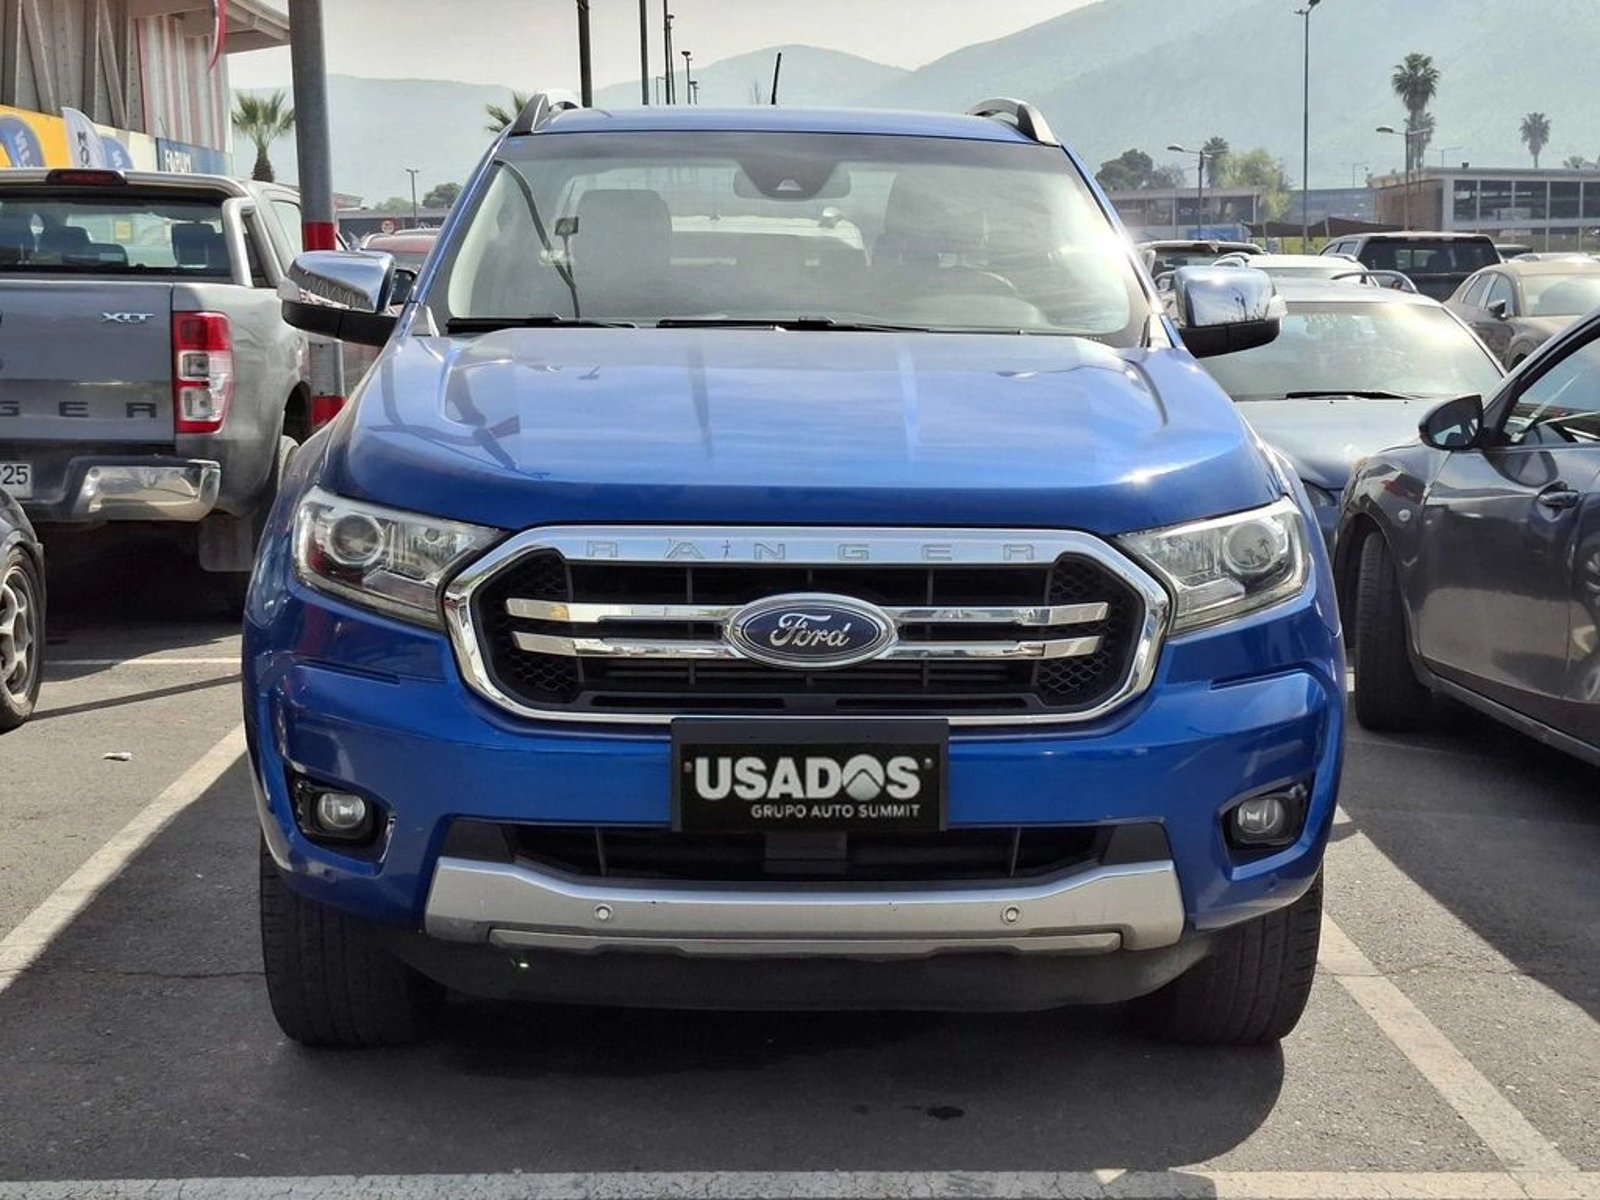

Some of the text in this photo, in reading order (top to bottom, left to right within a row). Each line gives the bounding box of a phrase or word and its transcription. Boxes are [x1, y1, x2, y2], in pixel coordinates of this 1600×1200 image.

[586, 539, 1035, 562] RANGER
[769, 613, 852, 649] Ford
[695, 754, 921, 801] USADOS
[751, 804, 921, 819] GRUPO AUTO SUMMIT
